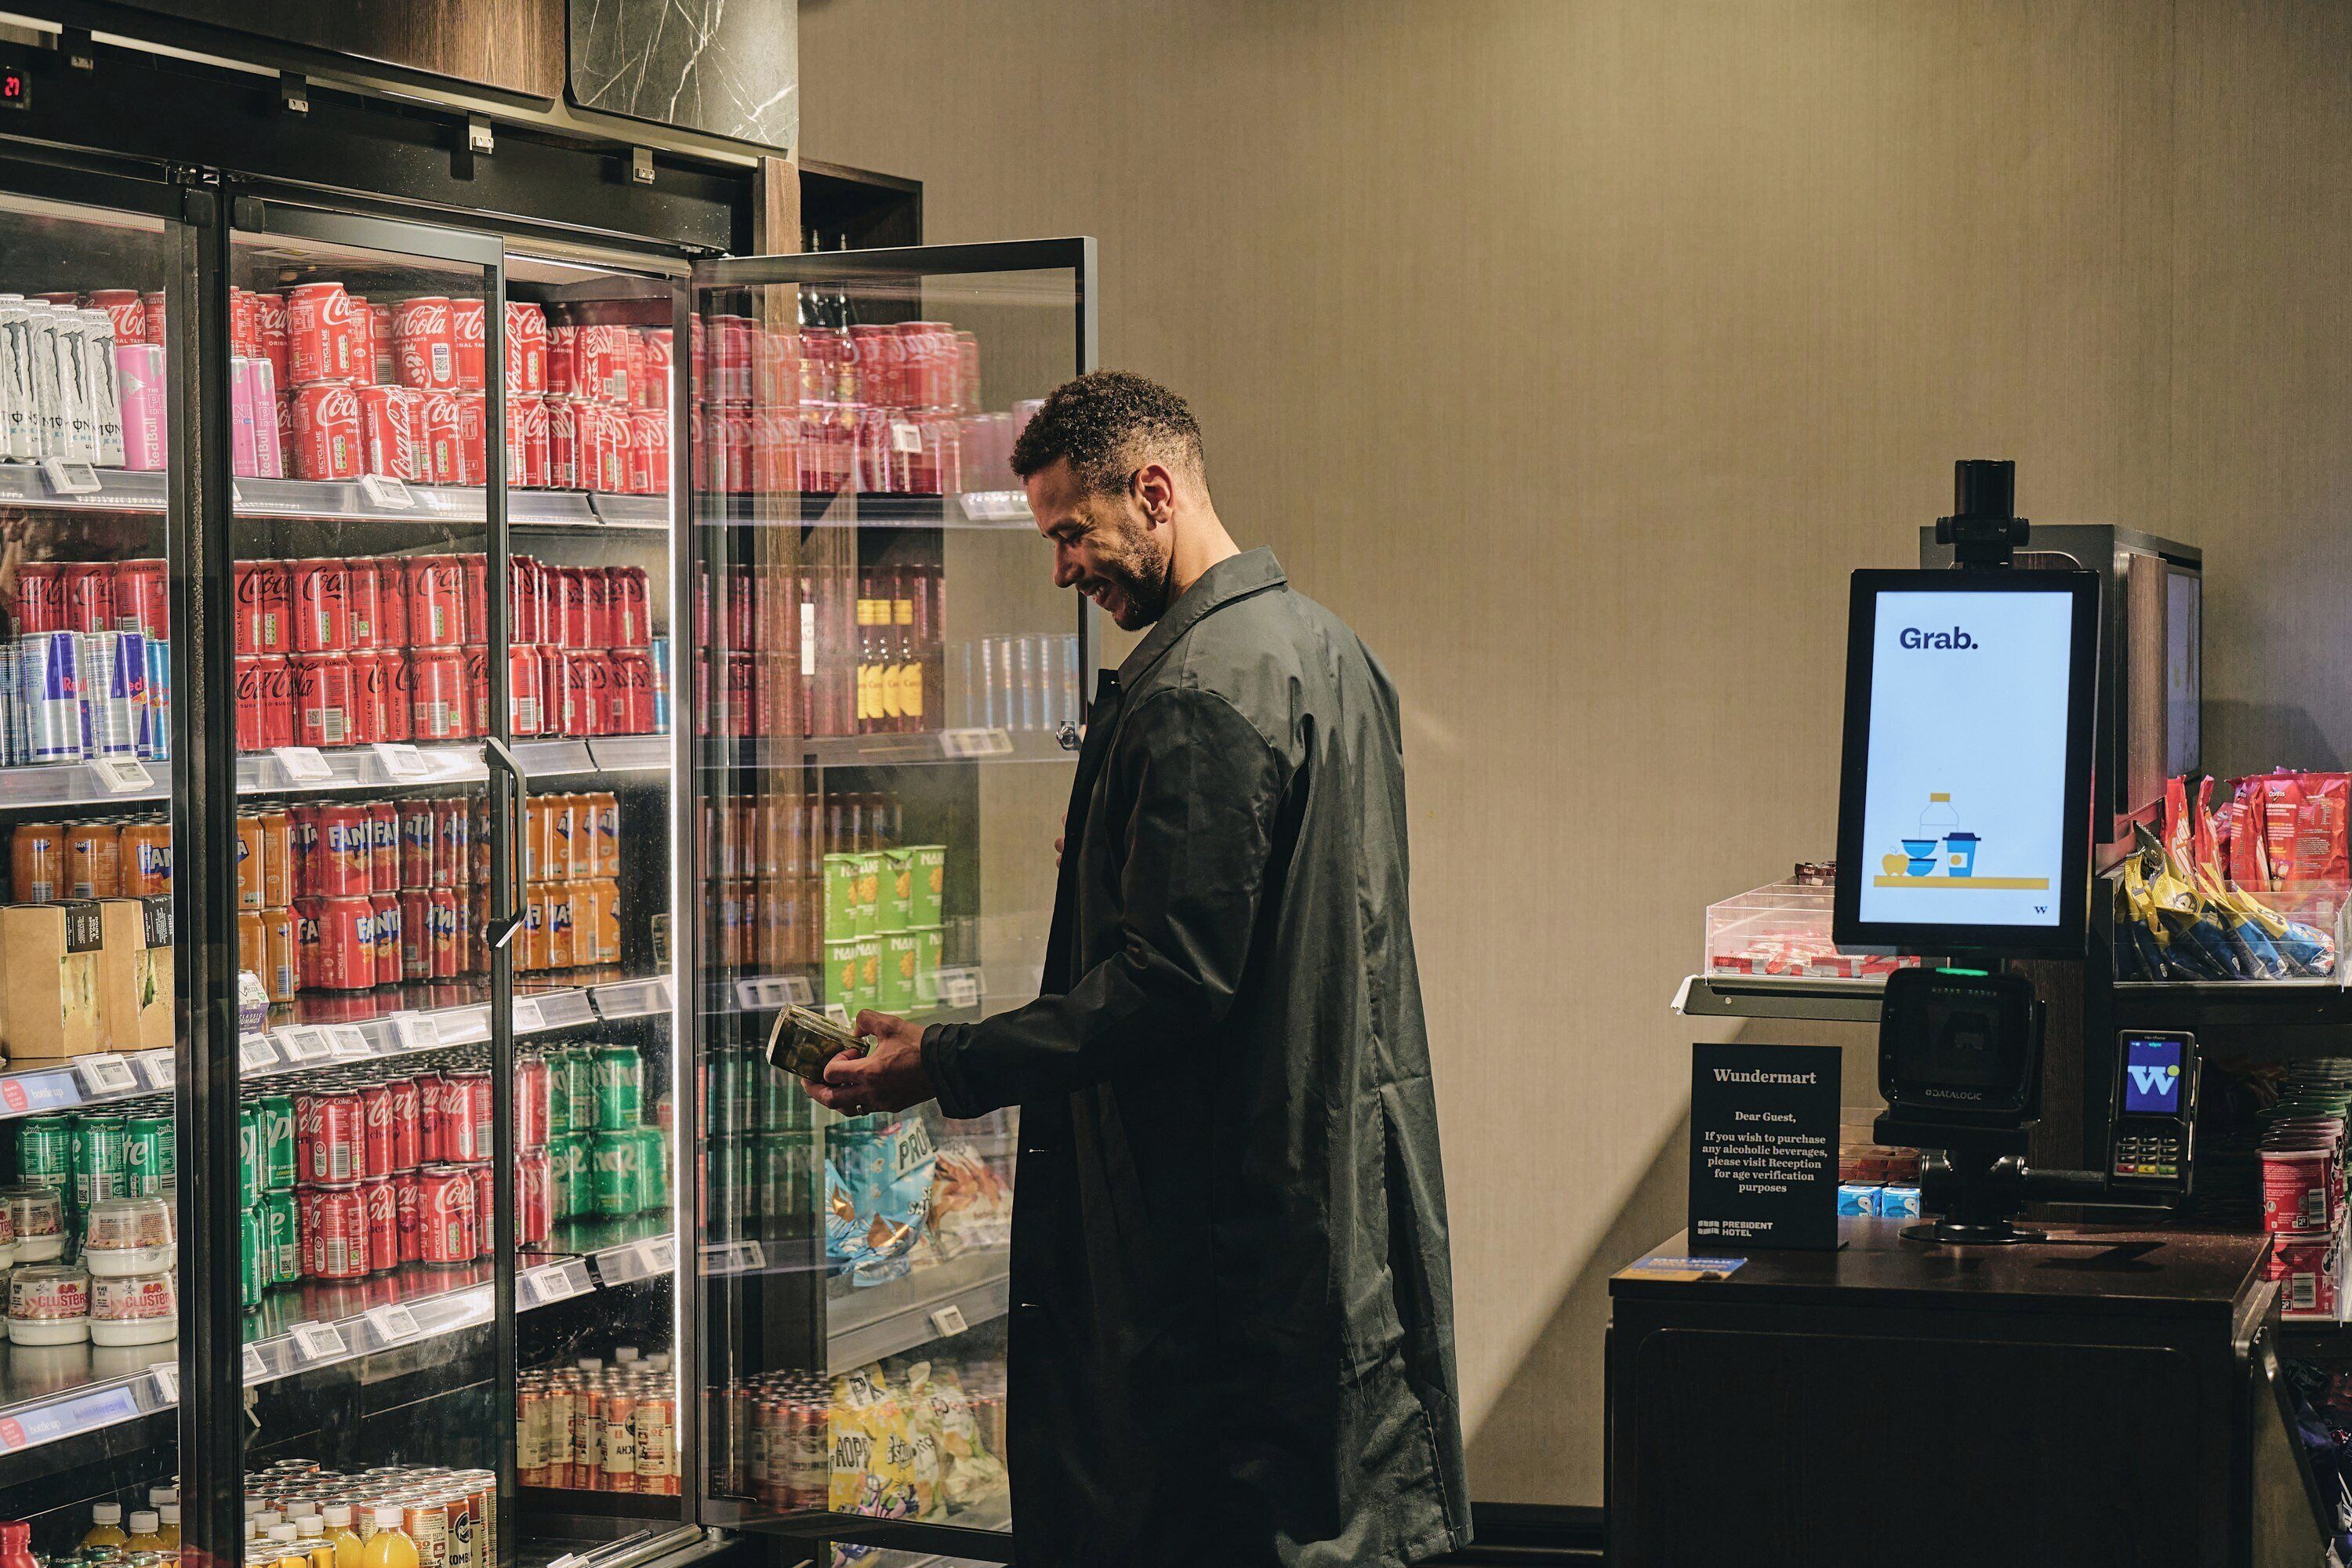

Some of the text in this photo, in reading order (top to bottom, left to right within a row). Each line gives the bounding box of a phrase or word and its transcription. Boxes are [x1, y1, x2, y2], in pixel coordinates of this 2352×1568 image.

[1900, 626, 1978, 650] Grab.
[1713, 1069, 1817, 1084] Wundermart
[2128, 1065, 2176, 1096] W
[1735, 1111, 1797, 1123] Dear Guest,
[1704, 1131, 1826, 1145] If you wish to purchase
[1702, 1145, 1828, 1158] any alcoholic beverages,
[1708, 1156, 1822, 1170] please visit Reception
[1715, 1168, 1815, 1181] for age verification
[1739, 1184, 1787, 1194] purposes
[435, 1218, 441, 1226] ME
[1722, 1221, 1773, 1229] PRESIDENT
[1722, 1229, 1752, 1237] HOTEL
